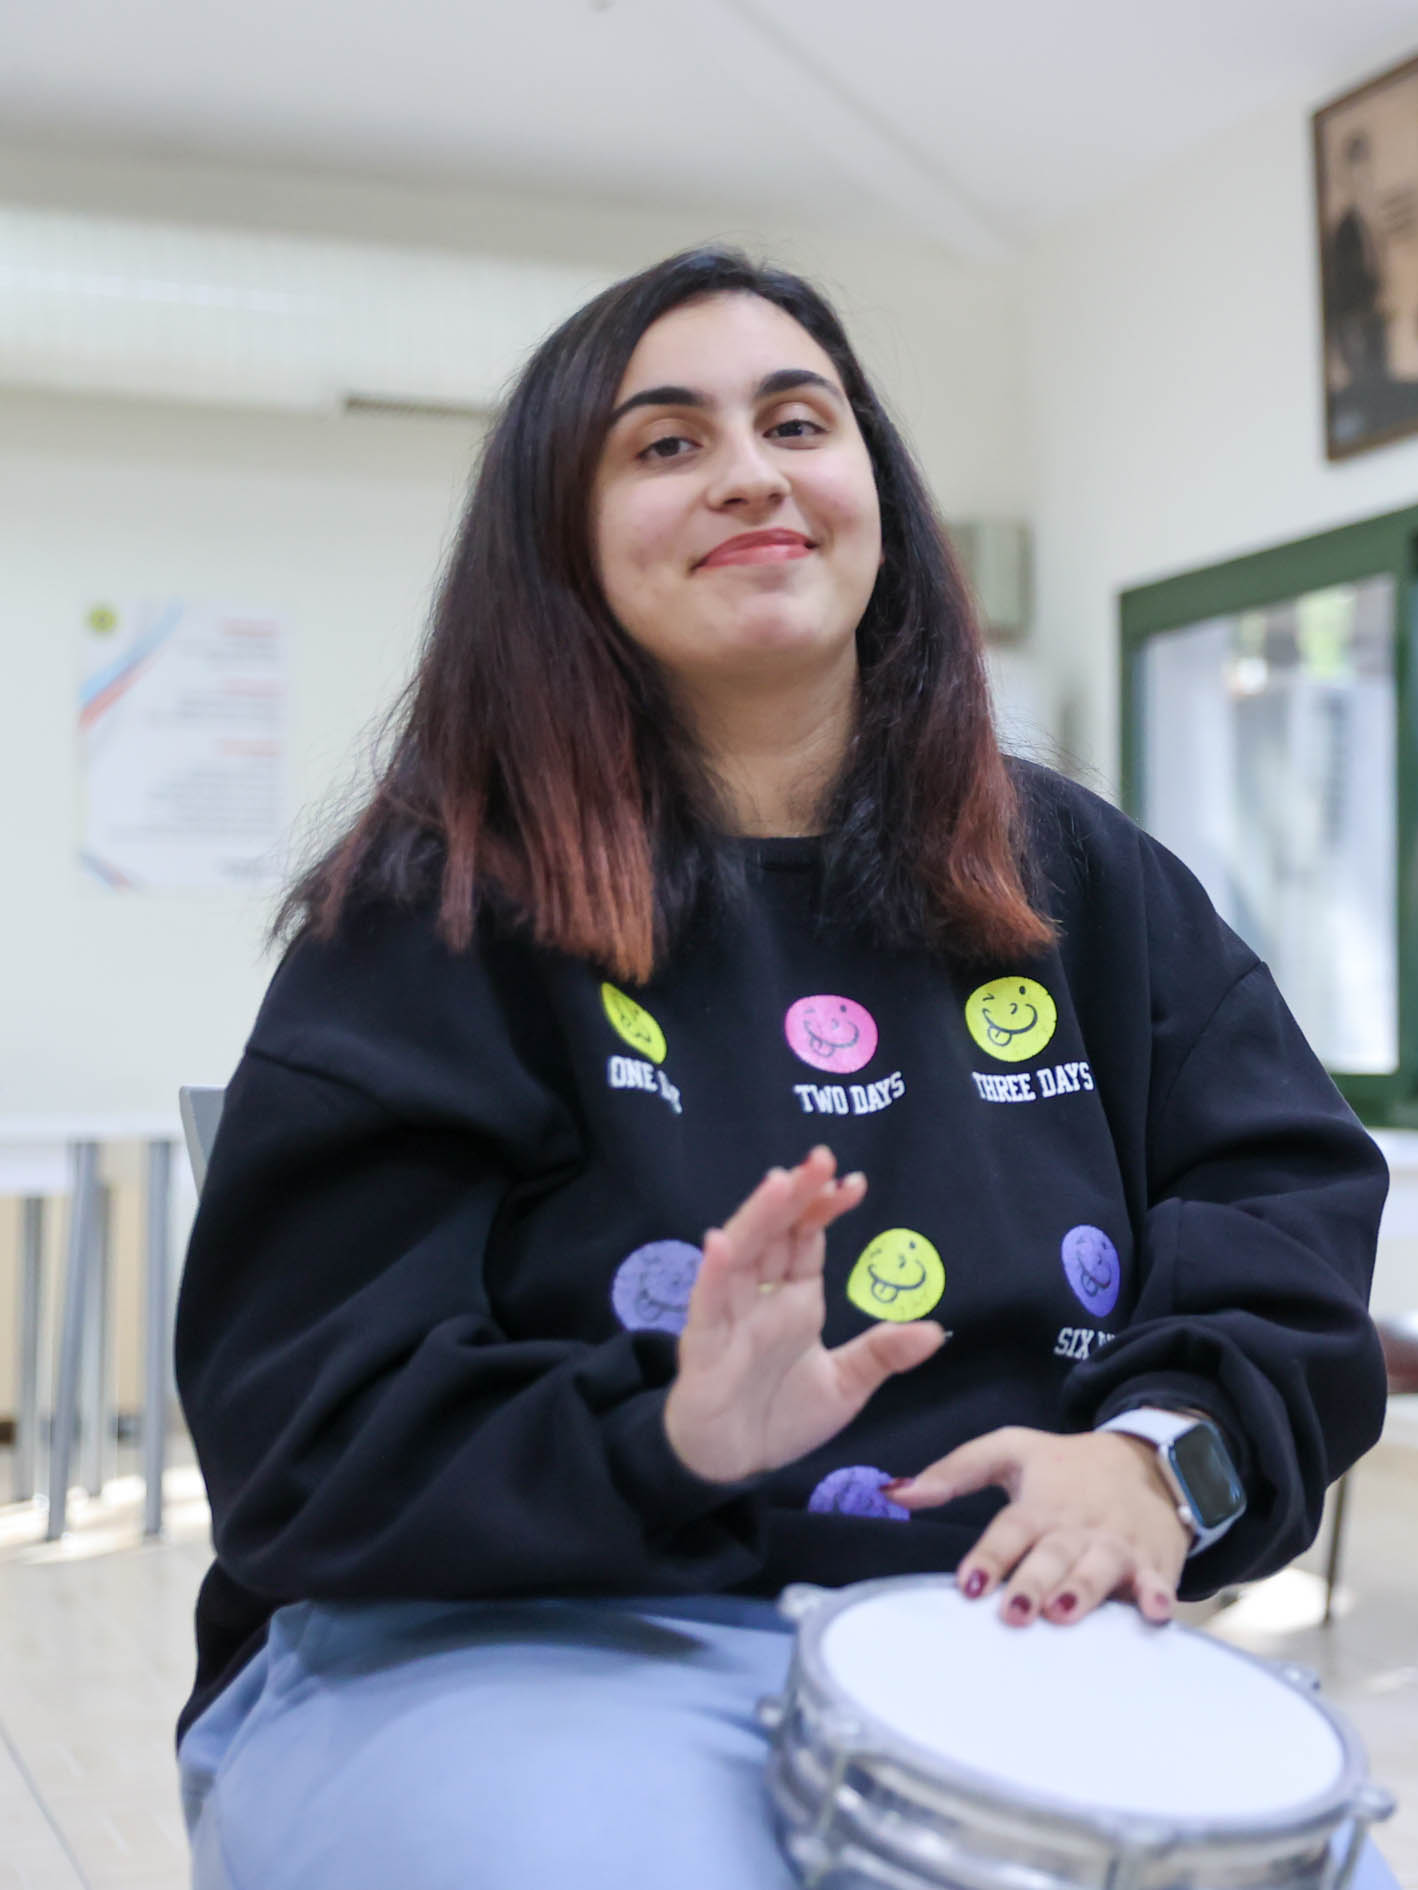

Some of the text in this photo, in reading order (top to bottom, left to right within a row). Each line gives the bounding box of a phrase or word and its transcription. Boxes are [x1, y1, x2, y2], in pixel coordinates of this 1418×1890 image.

[609, 1055, 658, 1092] ONE
[793, 1070, 905, 1115] TWO DAYS
[971, 1061, 1094, 1103] THREE DAYS
[1054, 1326, 1095, 1361] SIX
